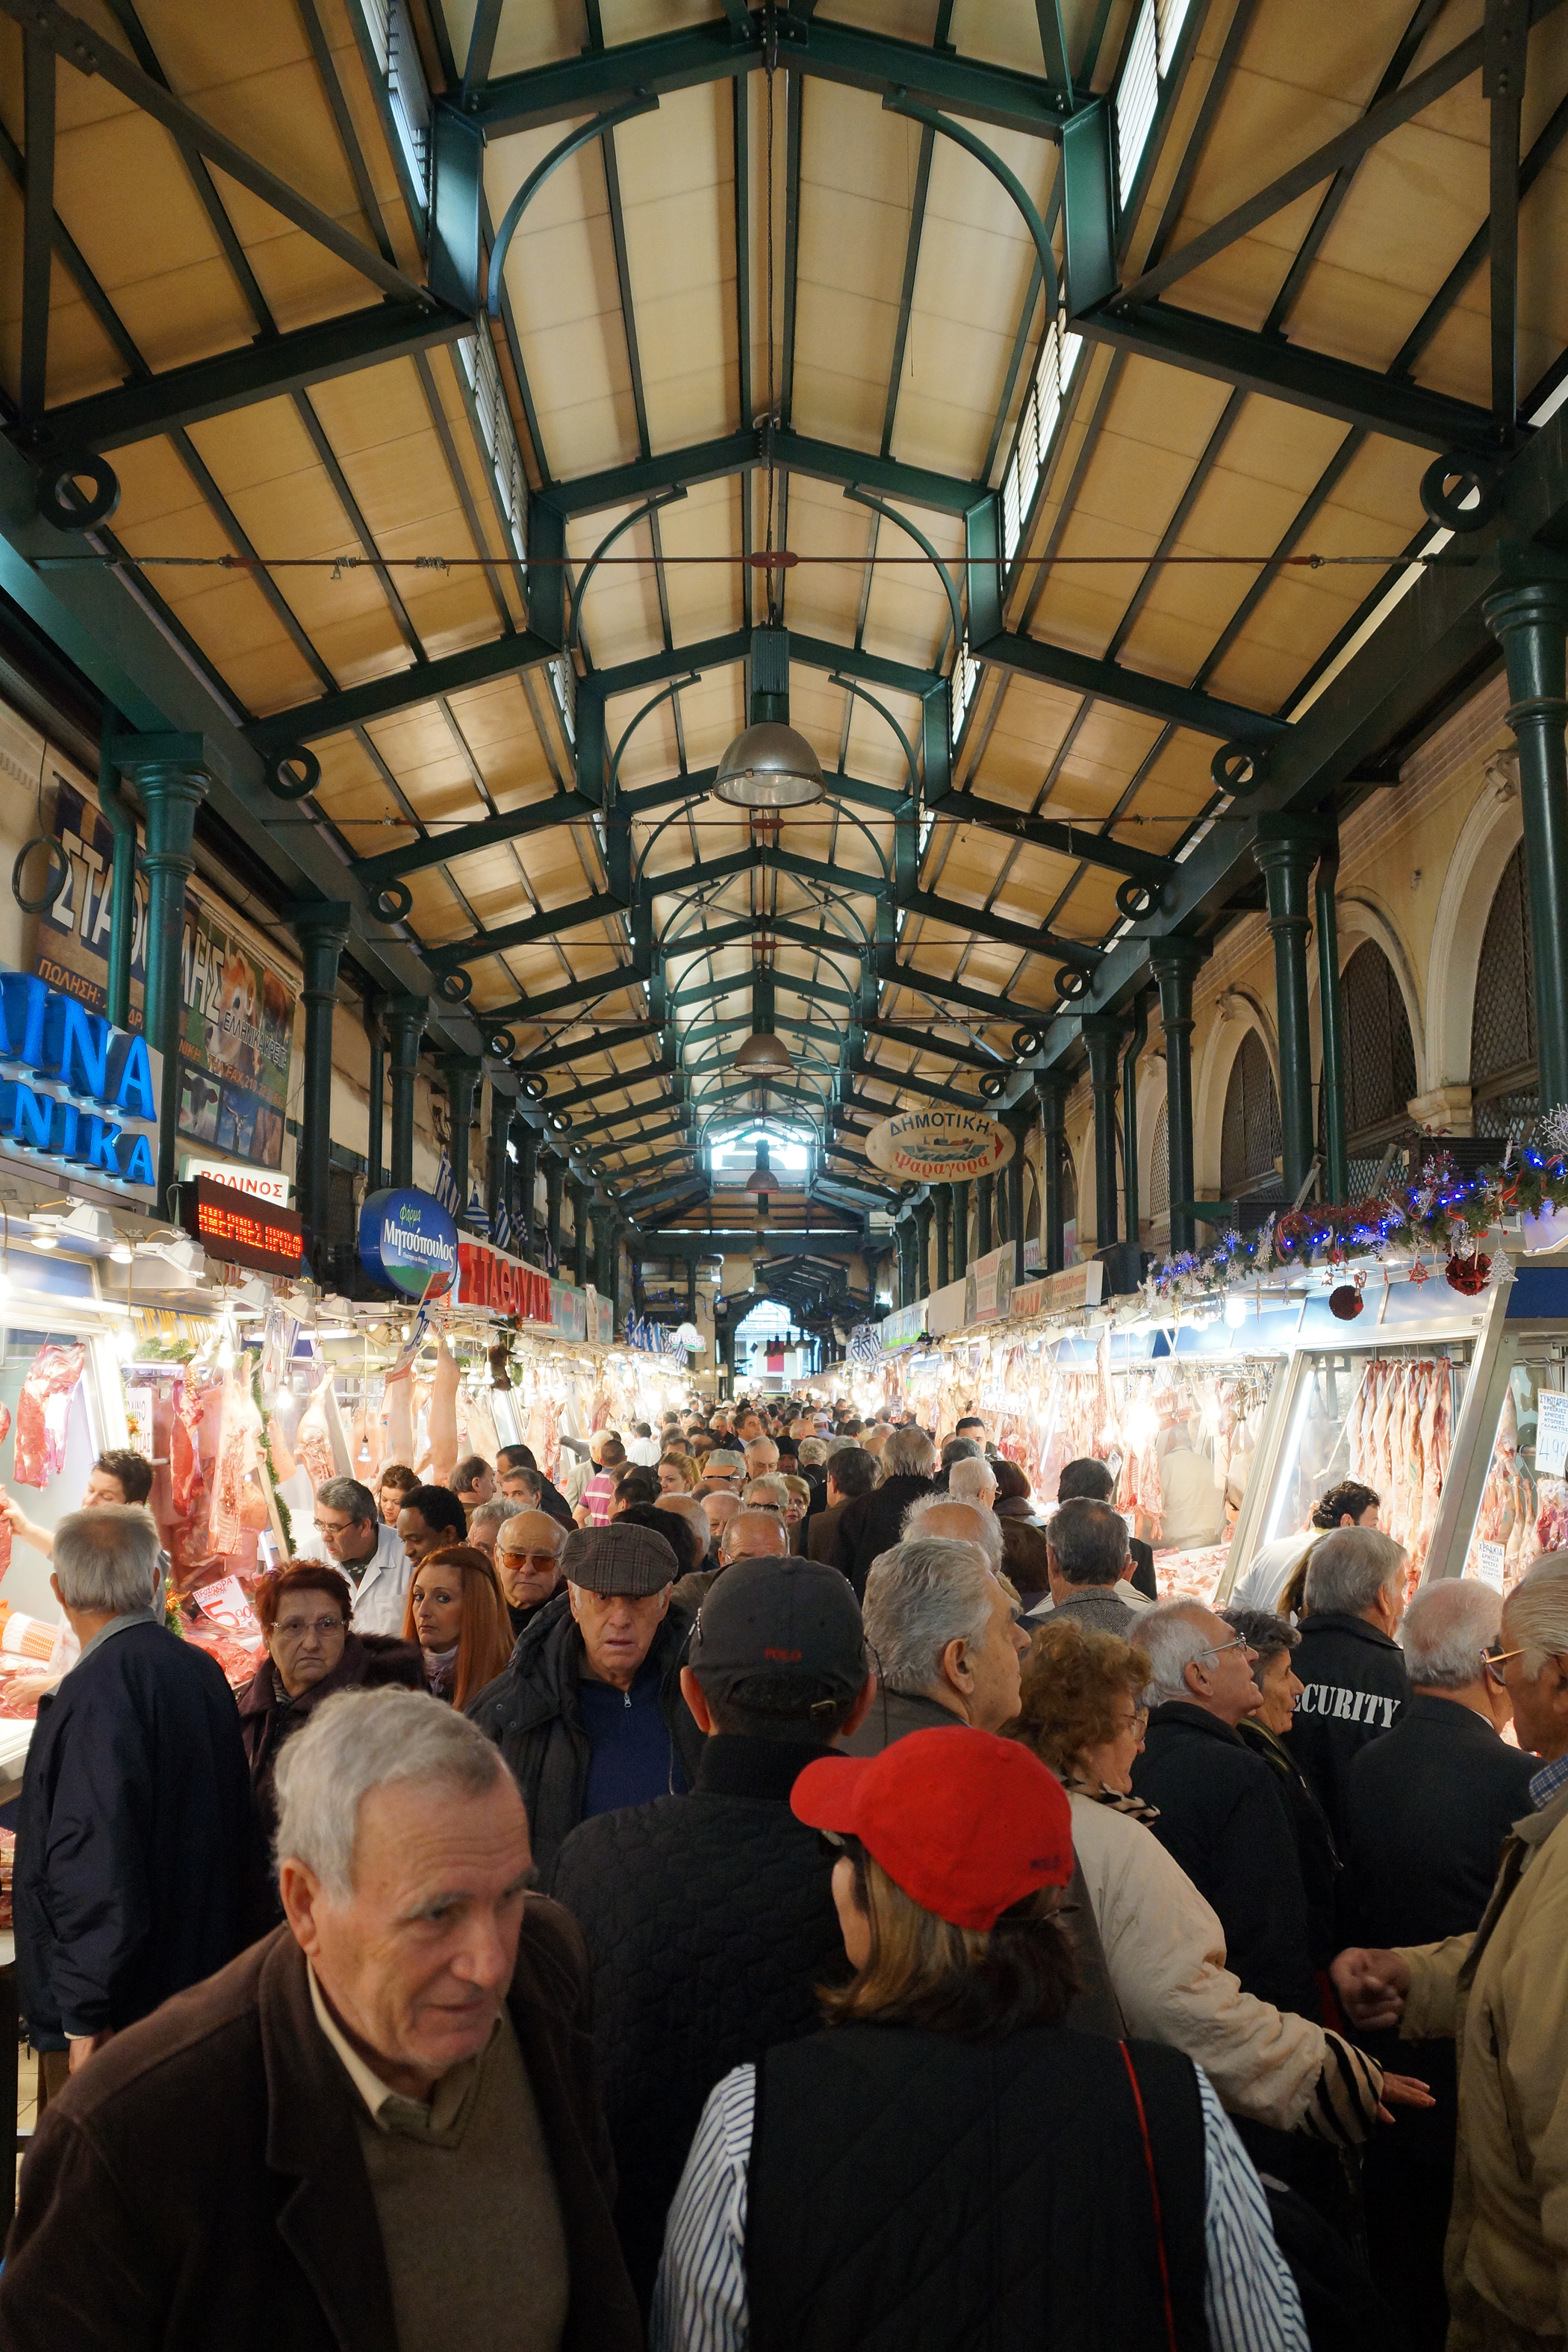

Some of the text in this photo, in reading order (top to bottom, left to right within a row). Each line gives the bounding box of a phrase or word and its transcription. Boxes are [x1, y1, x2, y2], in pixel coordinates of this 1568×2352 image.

[0, 972, 156, 1122] ΙΝΑ
[0, 1075, 155, 1187] ΝΙΚΑ
[890, 1112, 989, 1136] ΔΗΜΟΤΙΚΗ
[895, 1152, 990, 1178] Ψαραγορά
[399, 1203, 421, 1228] Φάρμα
[383, 1219, 455, 1269] Μητσόπουλος
[981, 1399, 1027, 1415] ΝΑΞΟΥ
[1543, 1405, 1567, 1414] ΦΡΕΣΚΙΕΣ
[1544, 1411, 1565, 1420] ΑΡΝΙΣΙΕΣ
[1482, 1560, 1499, 1568] ΦΡΕΣΚΑ
[1482, 1565, 1499, 1573] ΝΤΟΠΙΑ
[193, 1578, 233, 1600] ΠΡΟΣΦΟΡΑ
